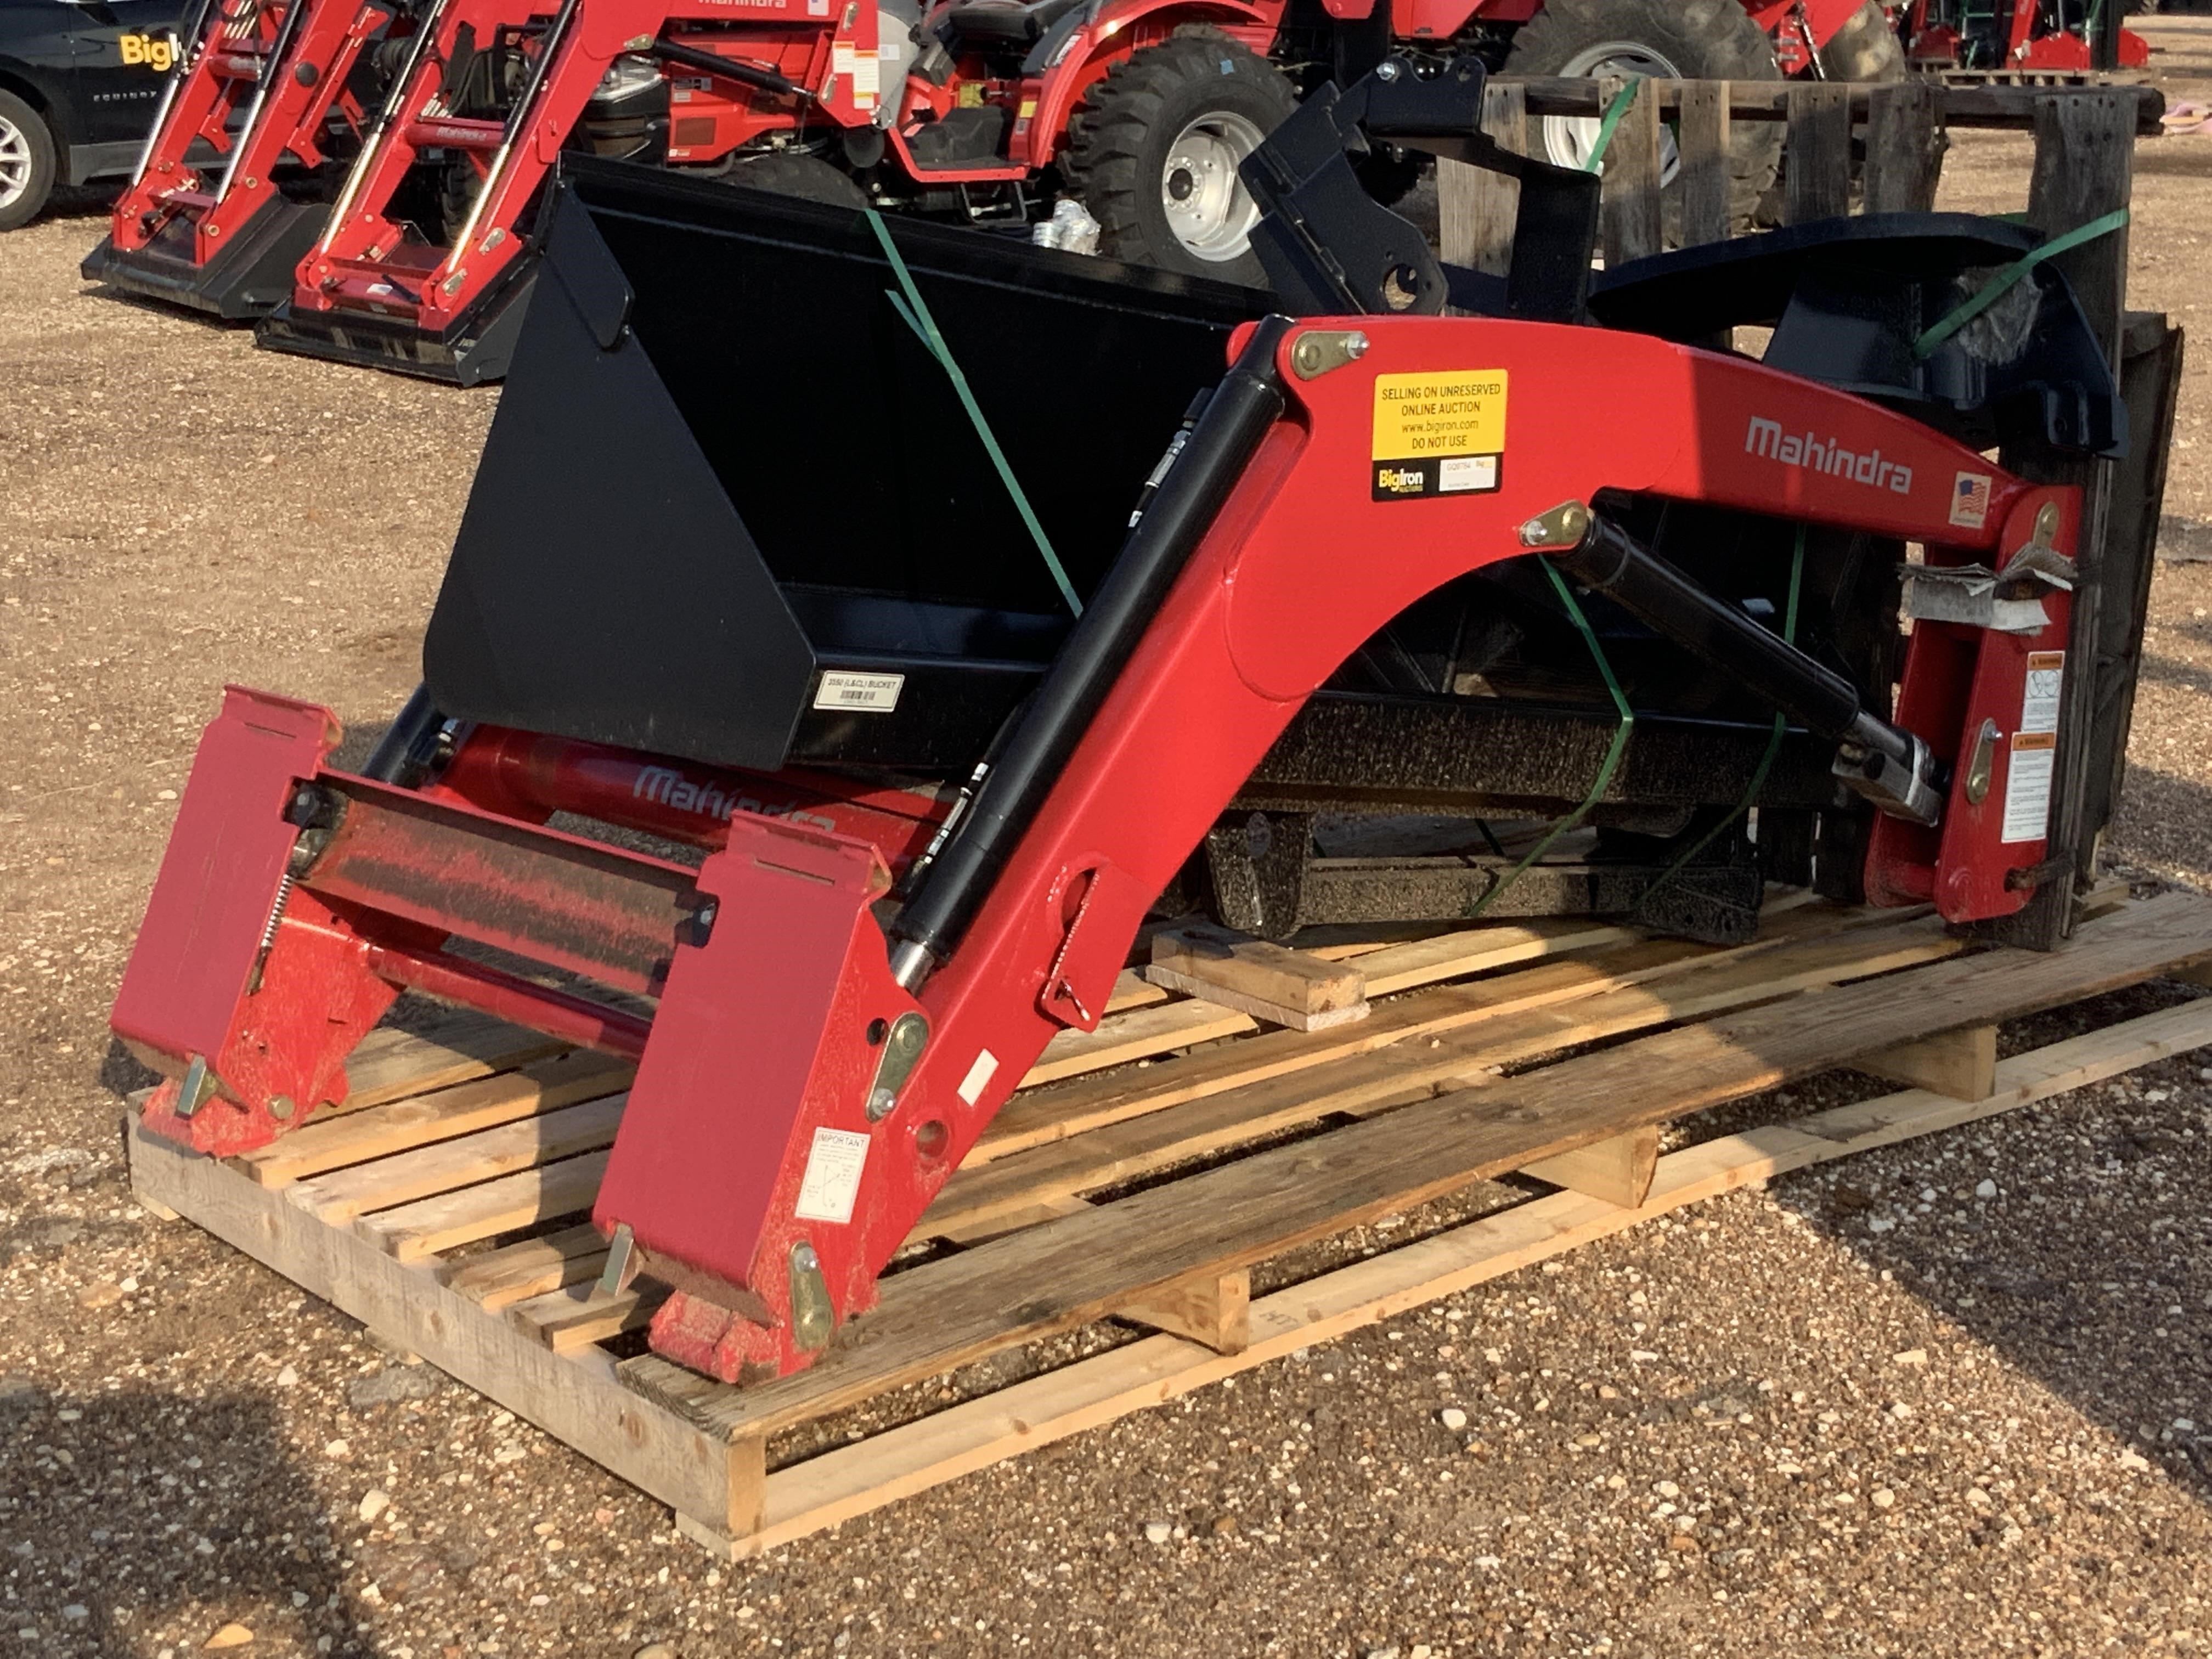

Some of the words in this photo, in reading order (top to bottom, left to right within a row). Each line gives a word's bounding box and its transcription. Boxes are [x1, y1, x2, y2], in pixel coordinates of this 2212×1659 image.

[1382, 387, 1421, 400] SELLING
[1424, 386, 1437, 398] ON
[1440, 383, 1500, 397] UNRESERVED
[1402, 403, 1436, 416] ONLINE
[1438, 401, 1481, 414] AUCTION
[1402, 420, 1479, 434] www.bigiron.com
[1412, 437, 1425, 449] DO
[1427, 436, 1447, 448] NOT
[1449, 435, 1468, 446] USE
[1745, 416, 1912, 494] Mahindra
[1379, 468, 1423, 492] BigIron
[868, 680, 897, 690] BUCKET
[817, 1133, 865, 1148] IMPORTANT
